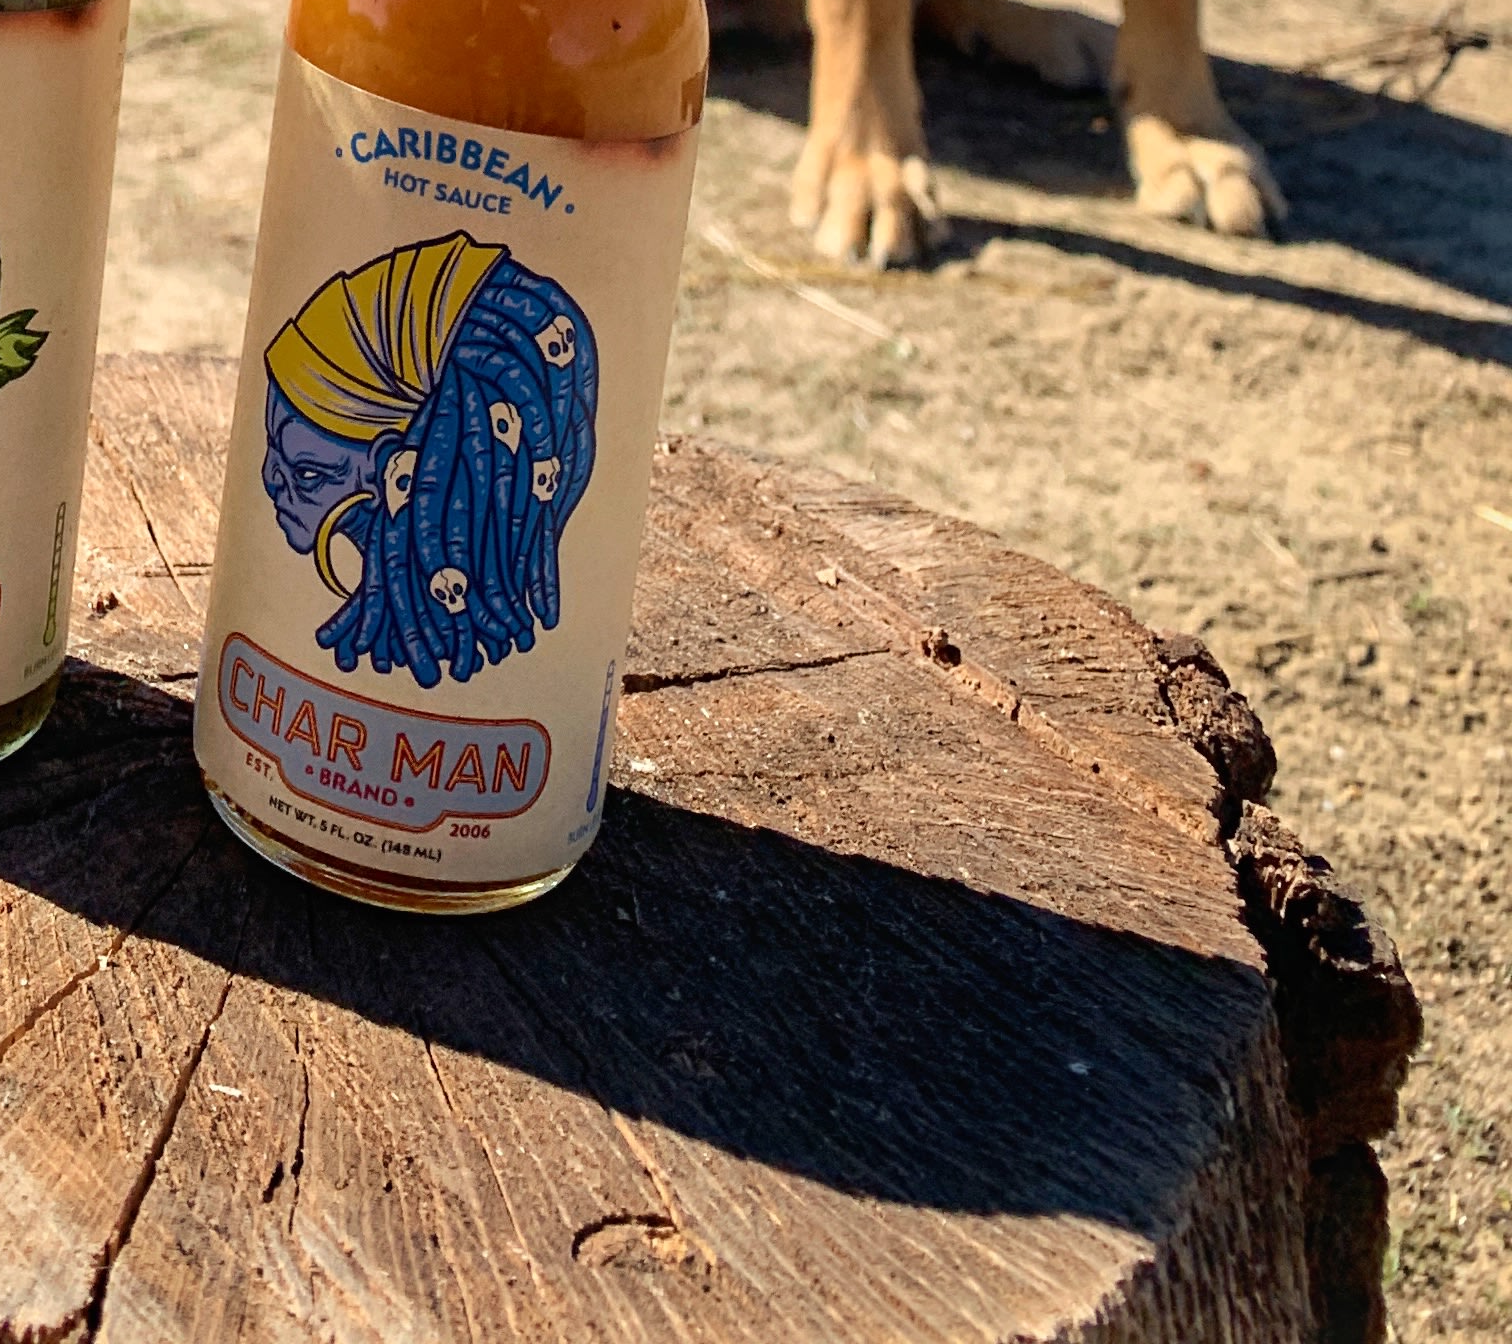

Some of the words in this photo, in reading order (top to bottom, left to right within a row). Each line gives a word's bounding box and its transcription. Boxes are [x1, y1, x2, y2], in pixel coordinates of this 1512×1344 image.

[350, 127, 564, 210] CARIBBEAN
[384, 167, 430, 196] HOT
[434, 183, 513, 214] SAUCE
[228, 656, 367, 771] CHAR
[390, 731, 531, 794] MAN
[319, 767, 398, 808] BRAND
[269, 795, 293, 816] NET
[294, 807, 317, 829] WT.
[320, 820, 328, 832] 5
[330, 824, 350, 840] FL.
[353, 831, 377, 849] OZ.
[413, 846, 443, 863] ML)
[449, 823, 492, 839] 2006
